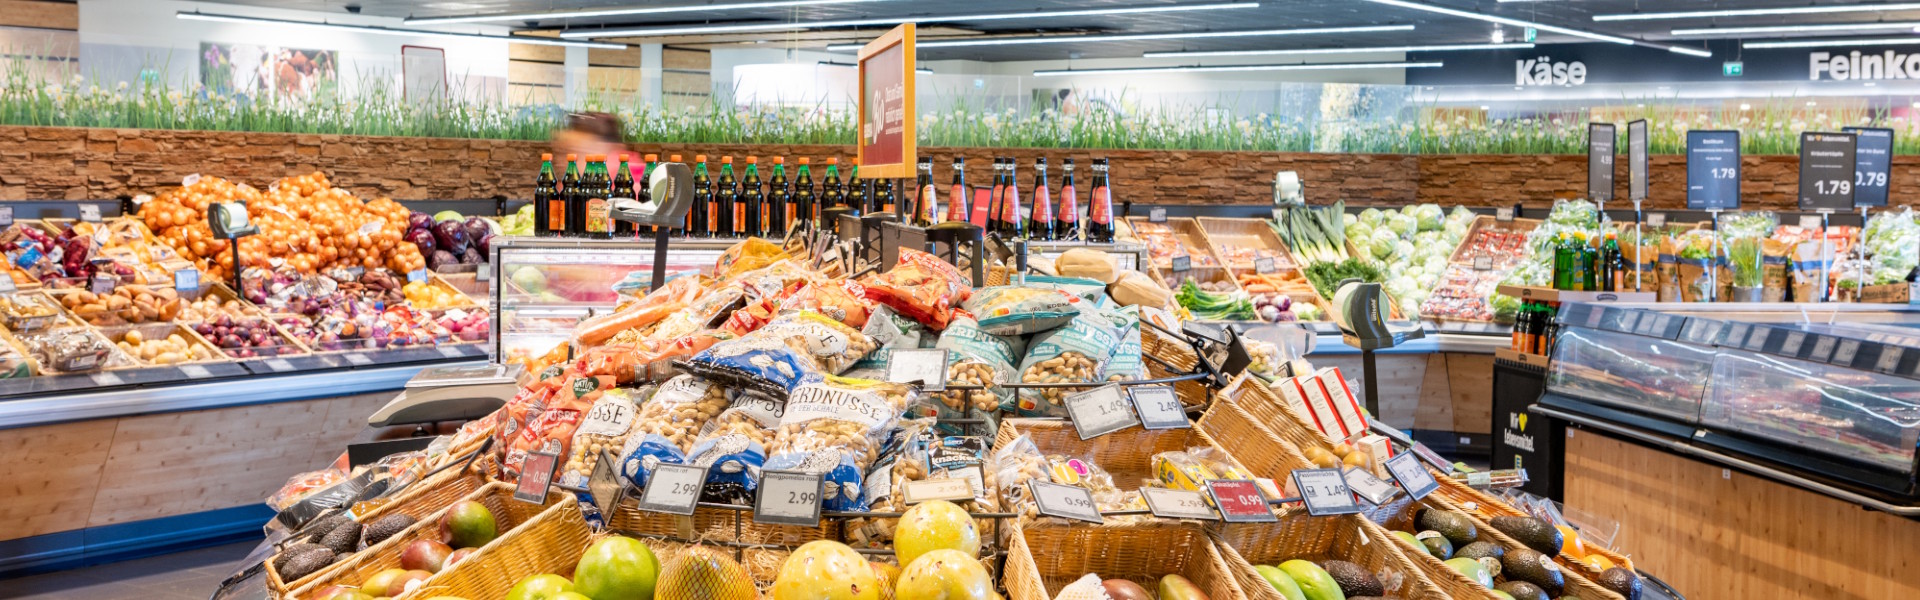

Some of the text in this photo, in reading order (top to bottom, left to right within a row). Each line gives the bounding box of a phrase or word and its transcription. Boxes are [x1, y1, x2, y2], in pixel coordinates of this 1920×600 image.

[1516, 56, 1586, 86] Käse
[1809, 50, 1920, 80] Feinko
[1711, 168, 1736, 179] 1.79
[1814, 180, 1851, 195] 1.79
[1098, 400, 1124, 415] 1.49
[1157, 401, 1178, 411] 2.49
[533, 471, 548, 483] 0.99
[672, 482, 697, 495] 2.99
[1324, 485, 1346, 496] 1.49
[788, 491, 816, 505] 2.99
[1064, 496, 1091, 508] 0.99
[1239, 495, 1262, 506] 0.99
